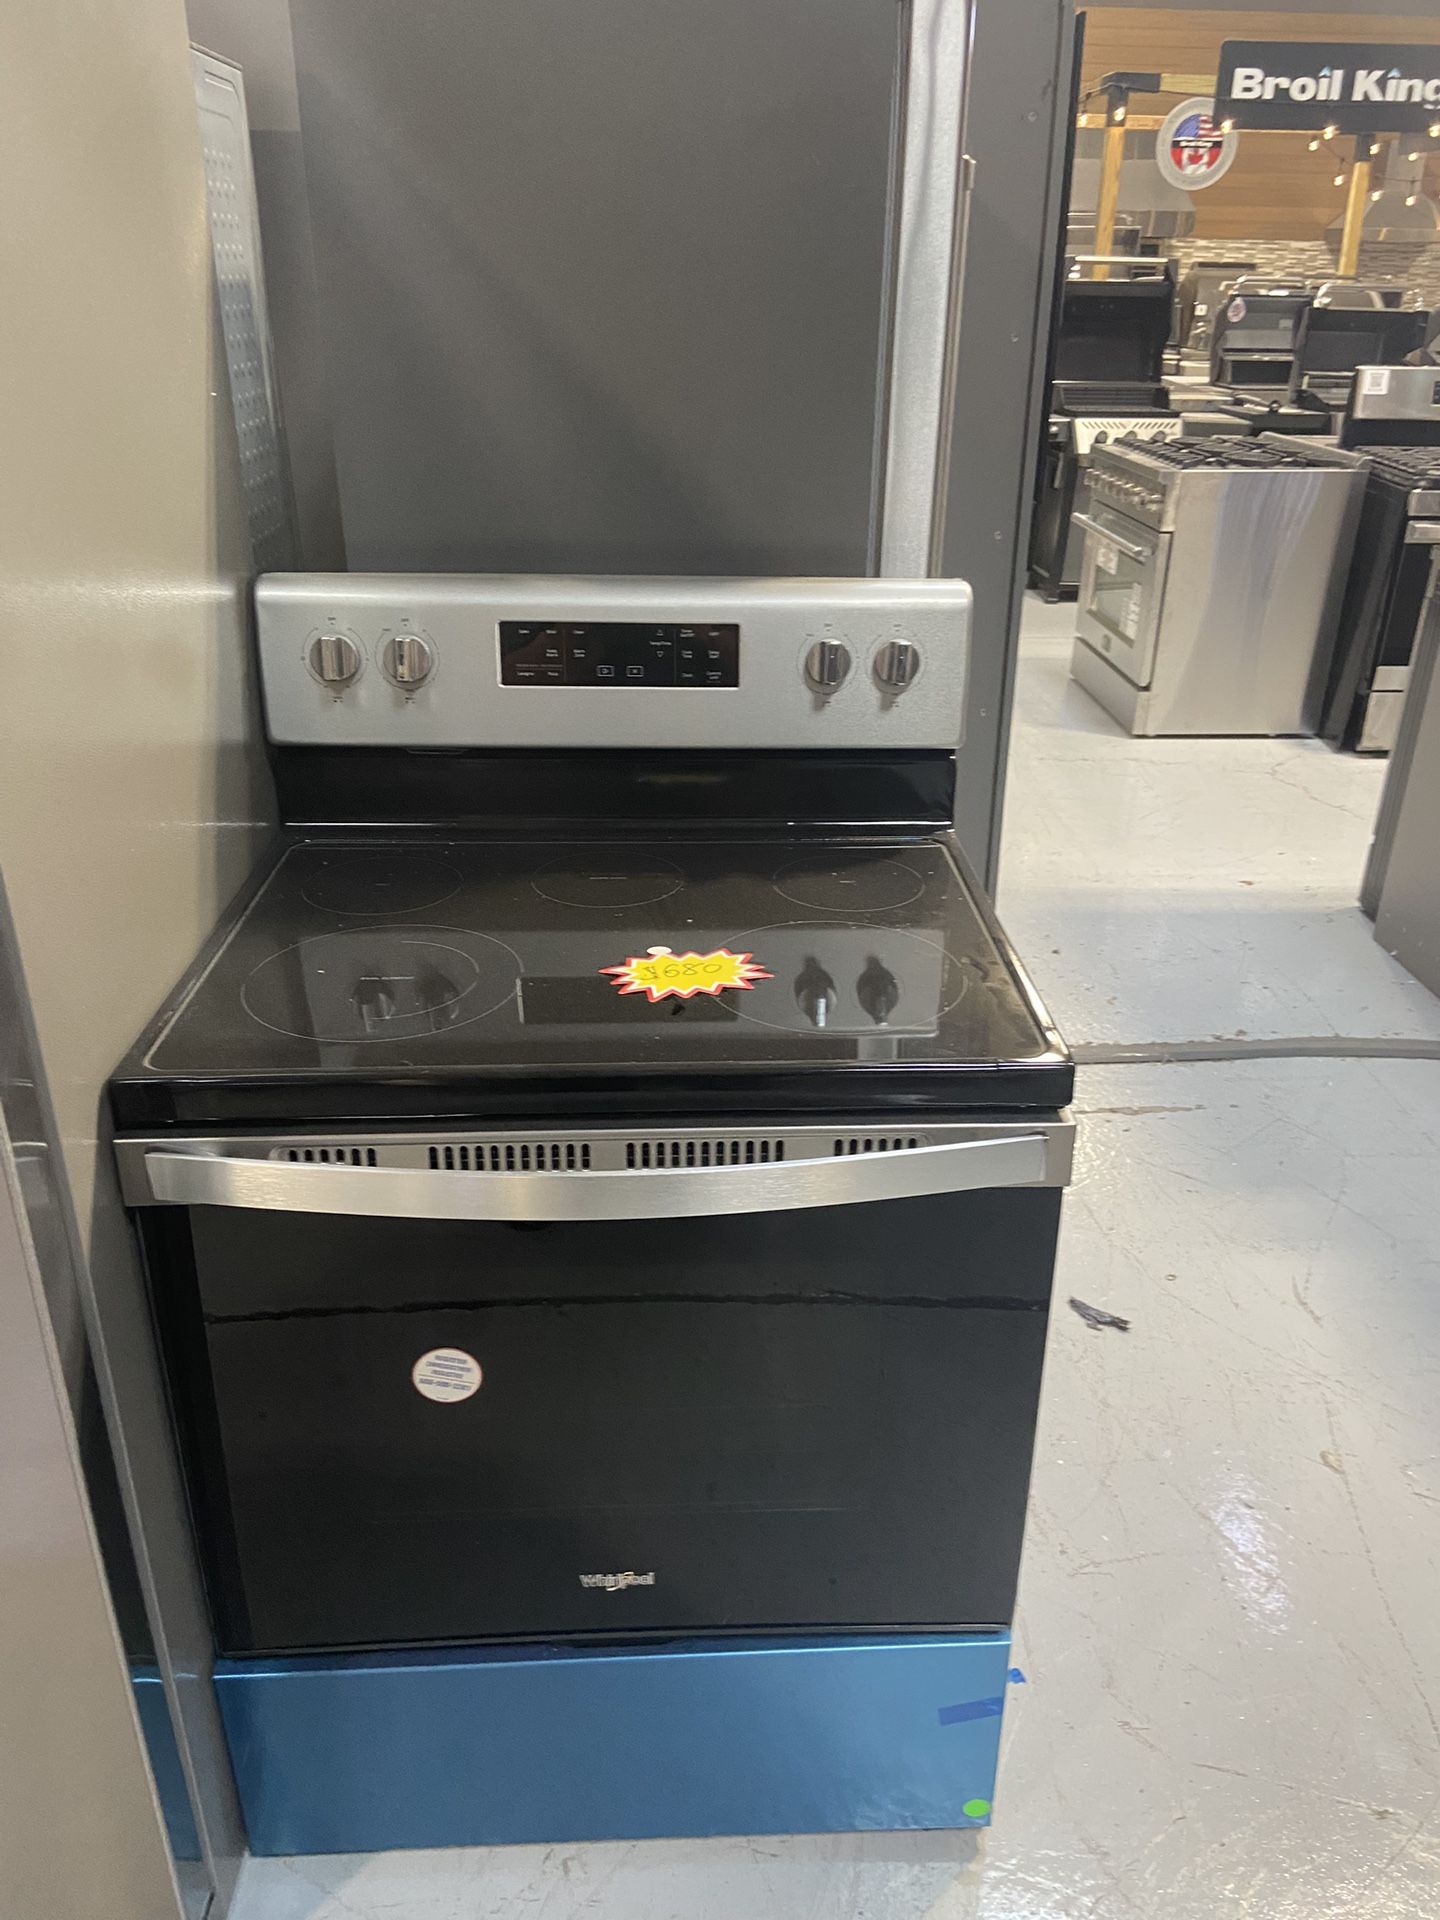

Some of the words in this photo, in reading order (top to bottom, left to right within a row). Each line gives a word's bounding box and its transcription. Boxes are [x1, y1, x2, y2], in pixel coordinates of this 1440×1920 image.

[1231, 66, 1343, 101] Broil
[641, 962, 723, 981] $680
[579, 1572, 655, 1591] Whirlpool
